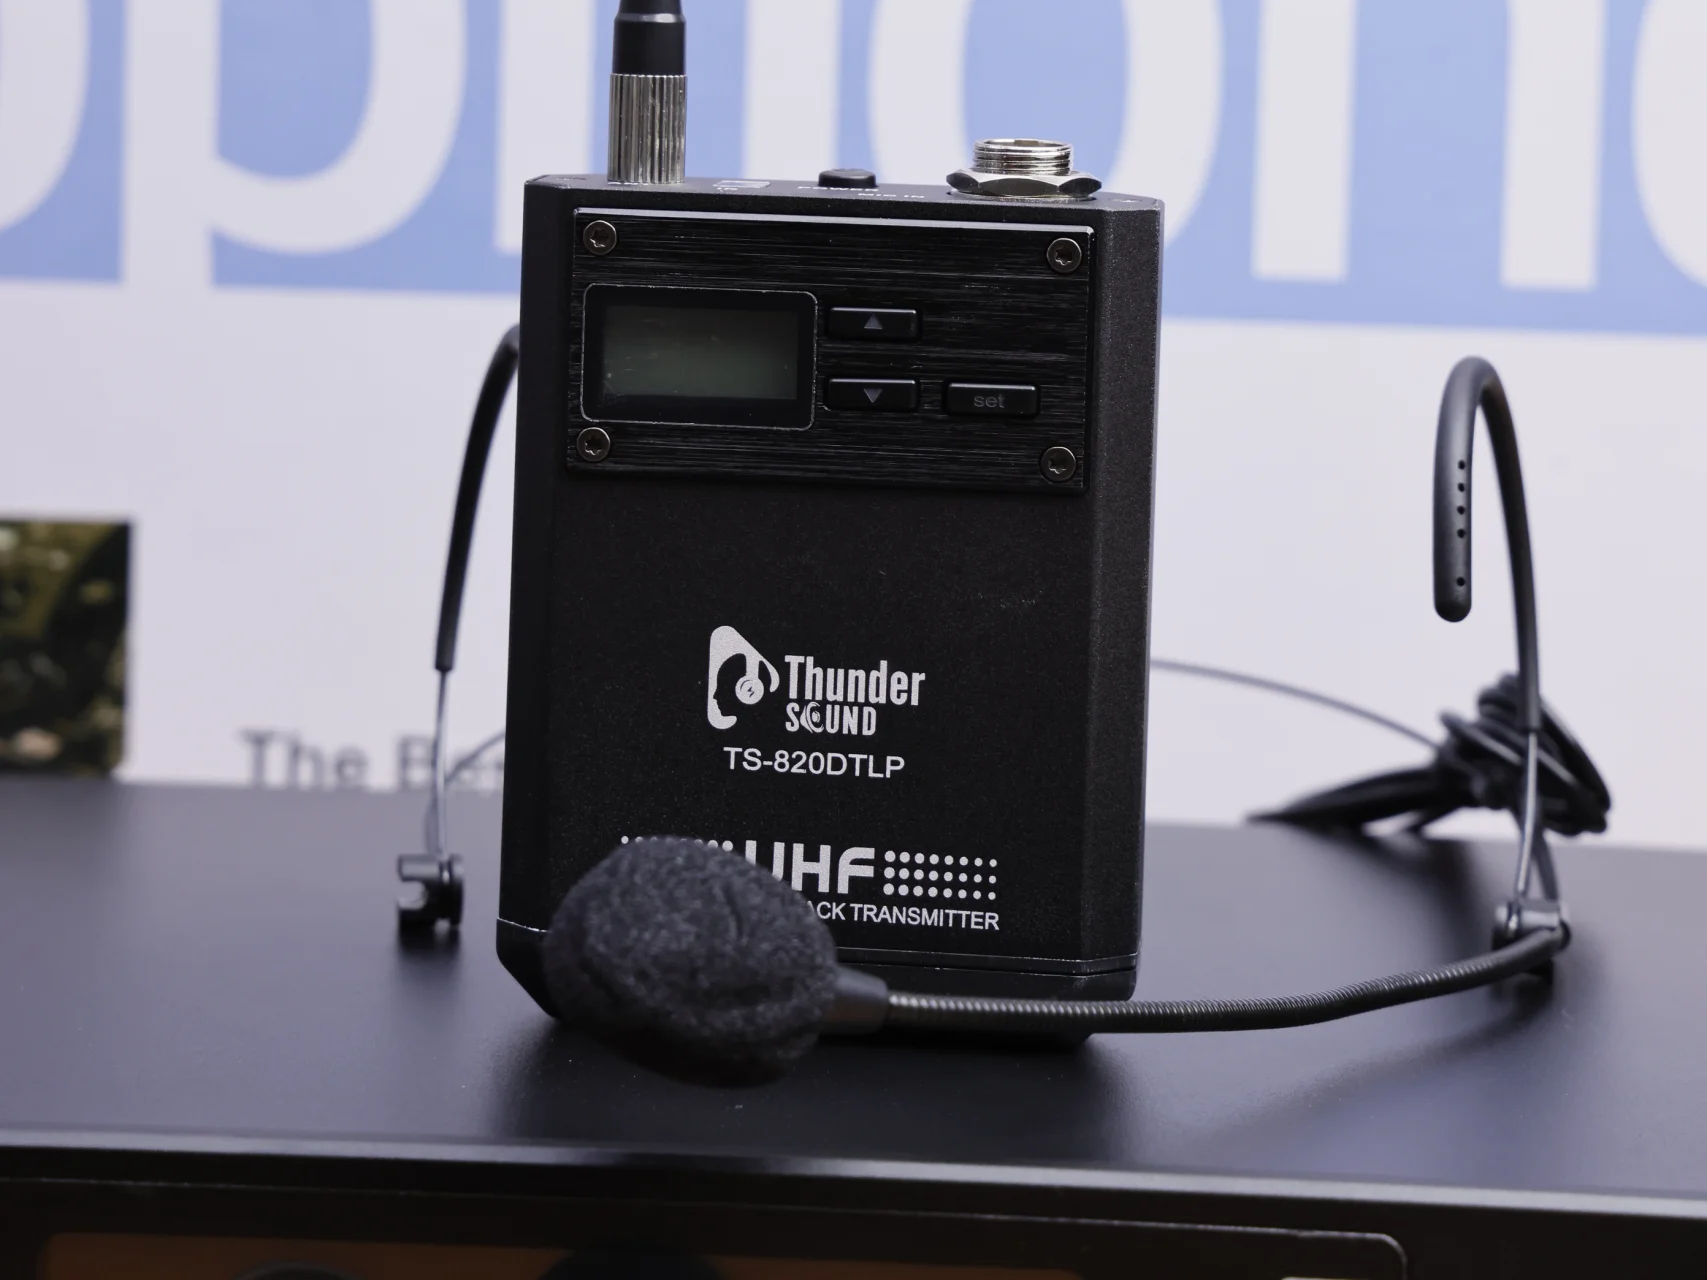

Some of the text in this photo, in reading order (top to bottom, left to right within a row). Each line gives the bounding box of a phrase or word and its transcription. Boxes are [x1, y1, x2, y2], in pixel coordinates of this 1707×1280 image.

[973, 393, 1005, 408] set
[784, 655, 926, 706] Thunder
[785, 701, 877, 736] SOUND
[723, 746, 905, 778] TS-820DTLP
[849, 903, 1000, 930] TRANSMITTER
